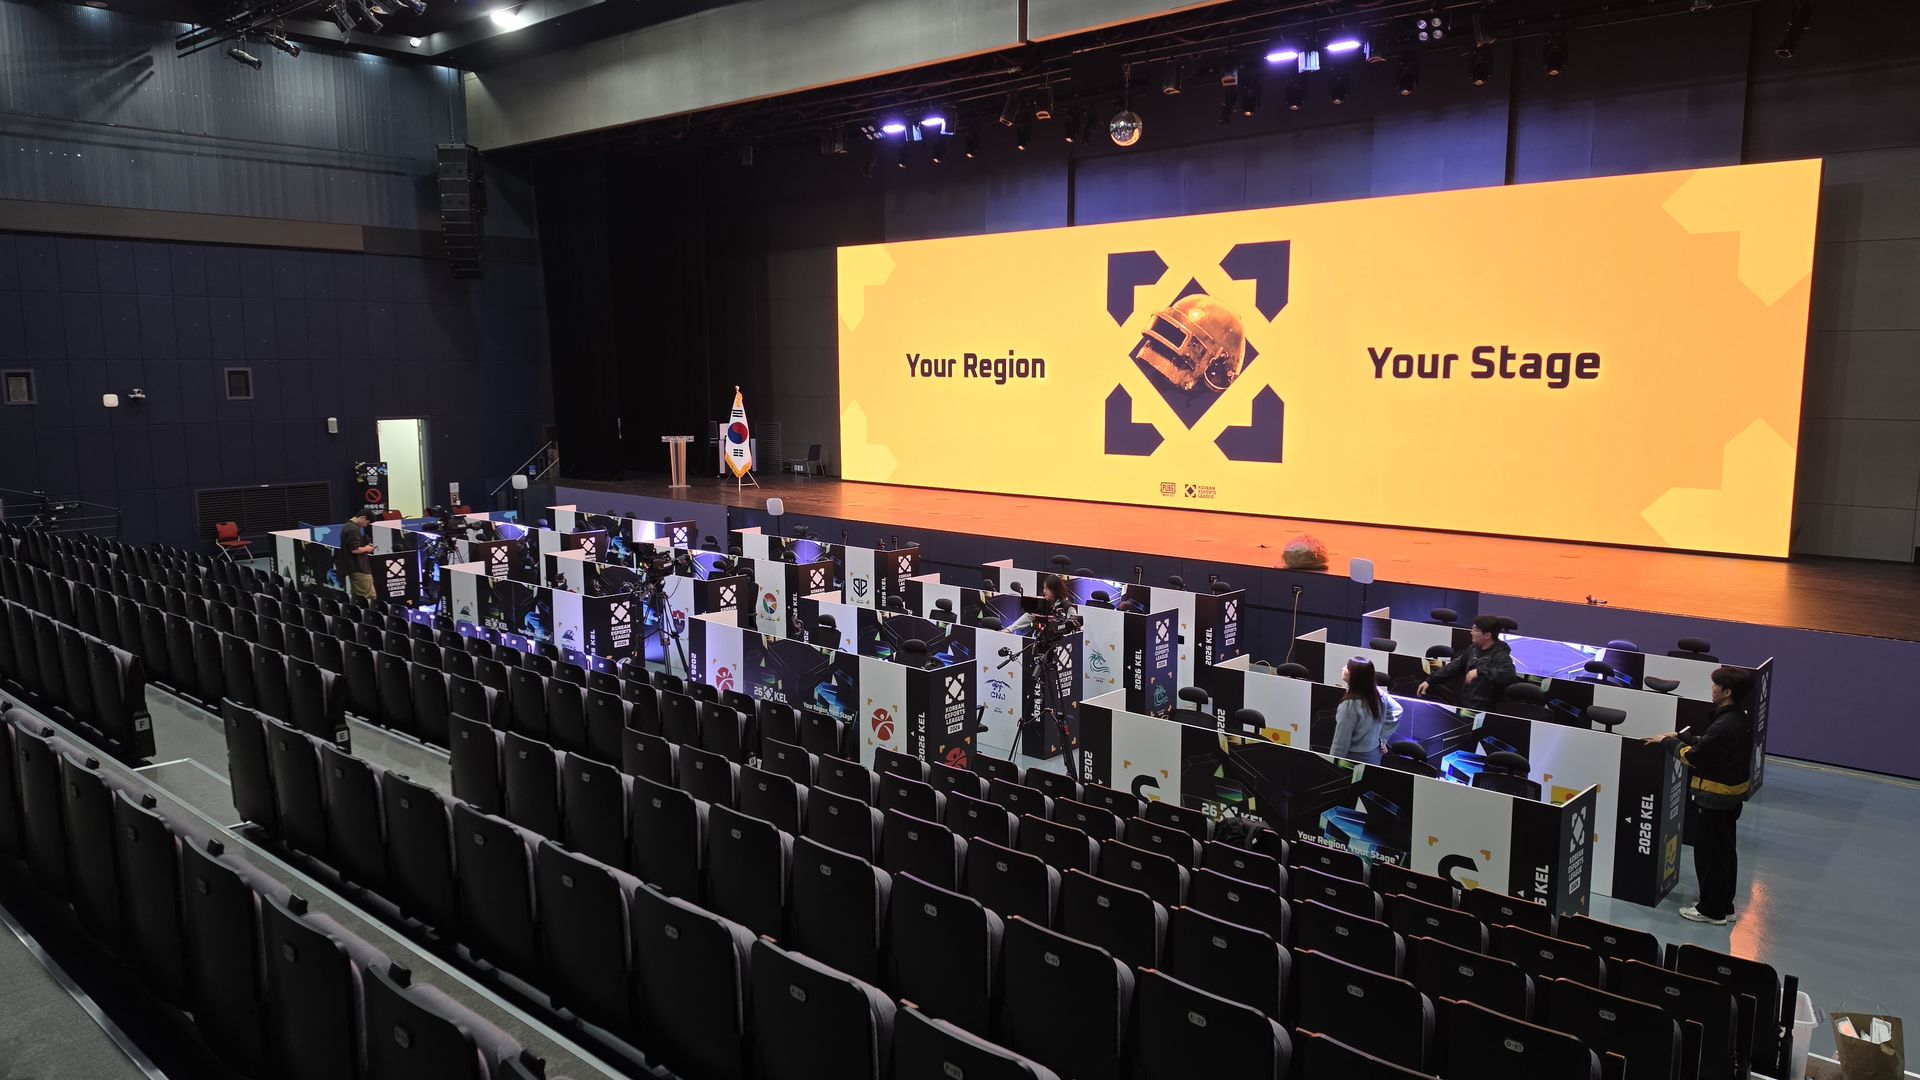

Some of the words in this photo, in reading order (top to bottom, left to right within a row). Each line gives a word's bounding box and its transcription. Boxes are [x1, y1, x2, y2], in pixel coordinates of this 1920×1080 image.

[905, 353, 957, 378] Your
[963, 349, 1046, 385] Region
[1367, 346, 1459, 379] Your
[1470, 345, 1601, 389] Stage
[611, 629, 632, 637] ESPORTS
[1205, 627, 1213, 644] KEL
[1155, 643, 1169, 651] KOREAN
[1155, 648, 1170, 657] ESPORTS
[1134, 649, 1142, 669] KEL
[1155, 653, 1169, 661] LEAGUE
[1134, 670, 1142, 691] 2026
[753, 686, 763, 697] 26
[774, 692, 788, 704] KEL
[944, 708, 966, 720] ESPORTS
[945, 702, 965, 713] KOREAN
[918, 712, 926, 733] KEL
[945, 714, 965, 725] LEAGUE
[918, 735, 926, 761] 2026
[1084, 750, 1093, 781] 2026
[1201, 802, 1217, 817] 26
[1640, 793, 1654, 821] KEL
[1297, 830, 1318, 842] Your
[1317, 835, 1348, 852] Region,
[1638, 822, 1652, 855] 2026
[1569, 847, 1584, 864] KOREAN
[1568, 857, 1585, 874] ESPORTS
[1535, 864, 1550, 895] KEL
[1568, 867, 1583, 882] LEAGUE
